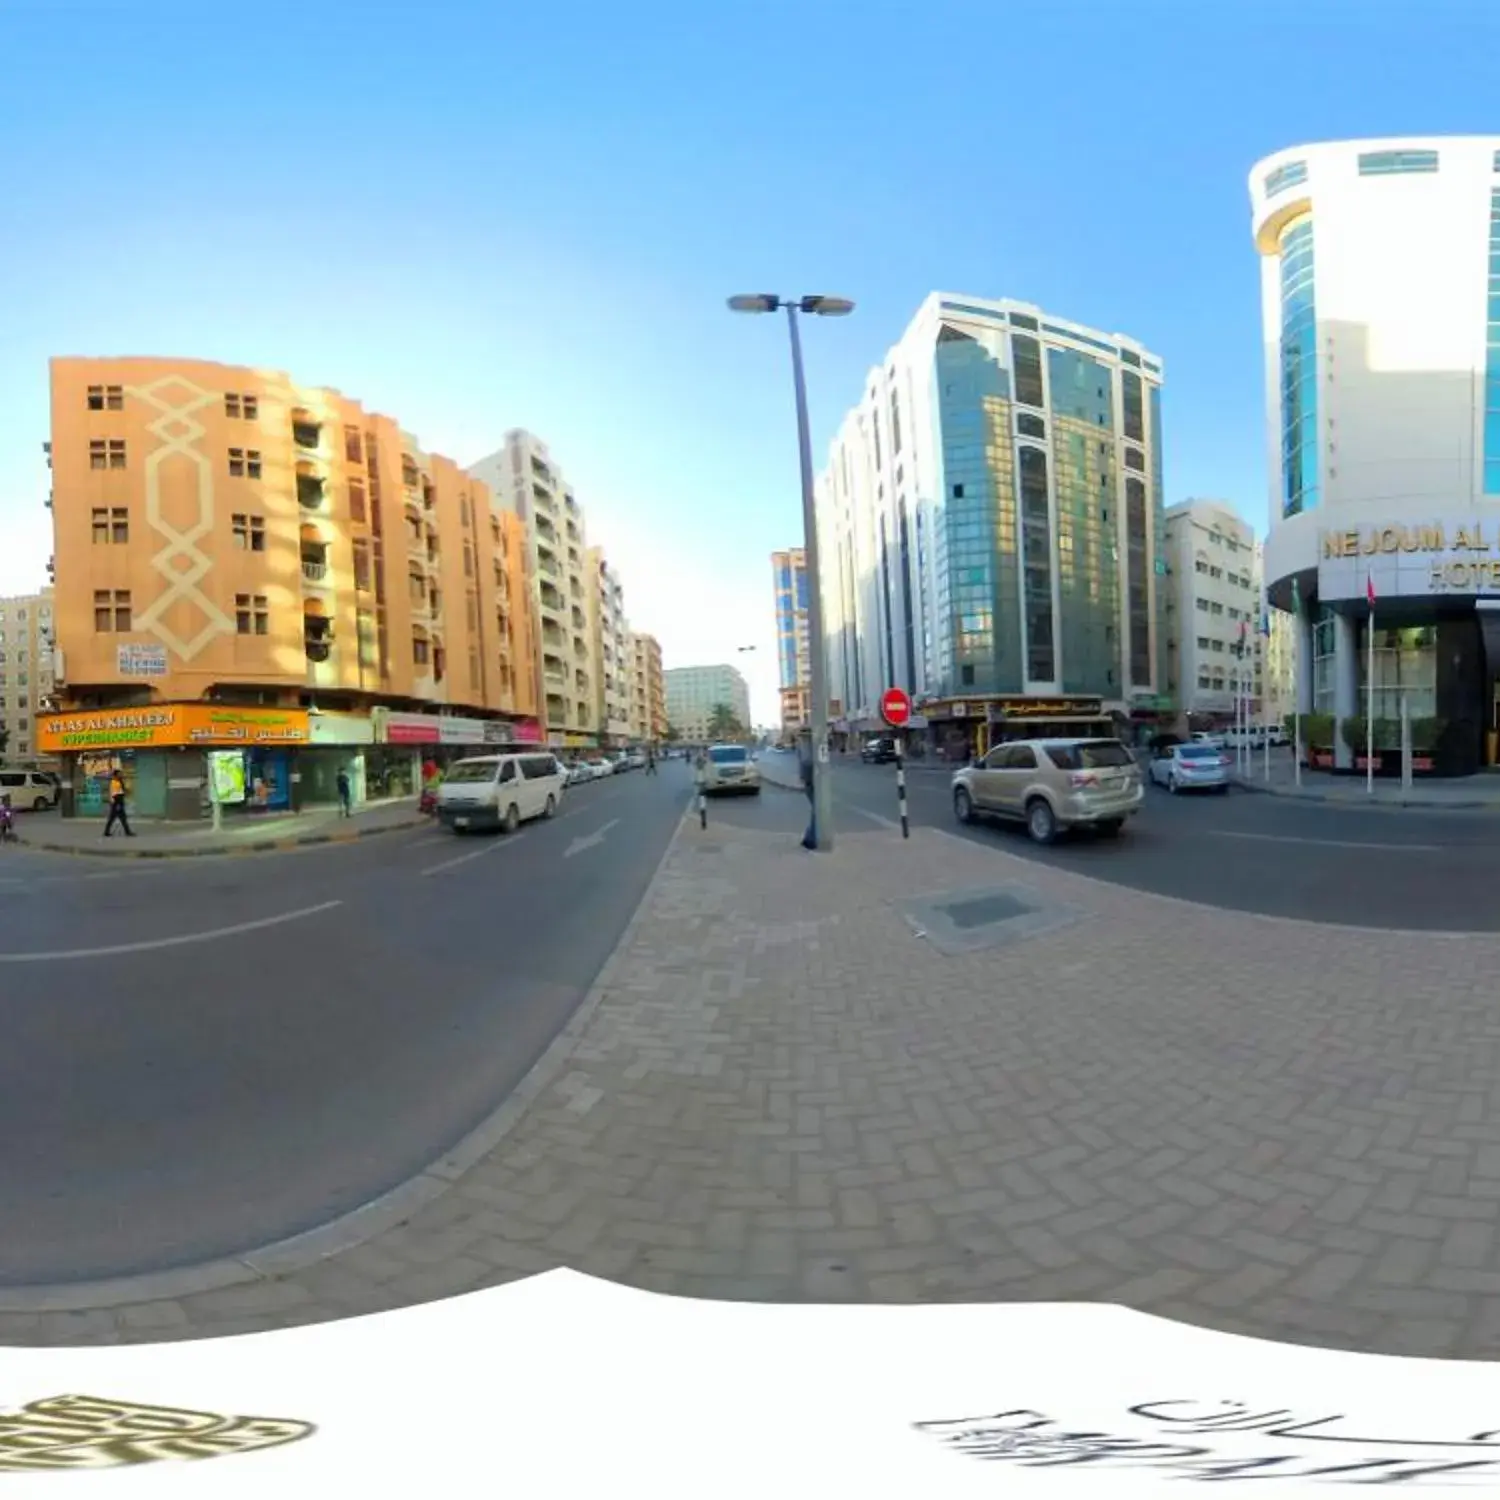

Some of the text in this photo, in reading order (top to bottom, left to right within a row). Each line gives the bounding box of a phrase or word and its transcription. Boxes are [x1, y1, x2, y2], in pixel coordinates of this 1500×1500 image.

[1324, 523, 1445, 559] NEJOUM
[1450, 521, 1489, 551] AL
[46, 711, 176, 733] ATLAS AL KHALEEJ
